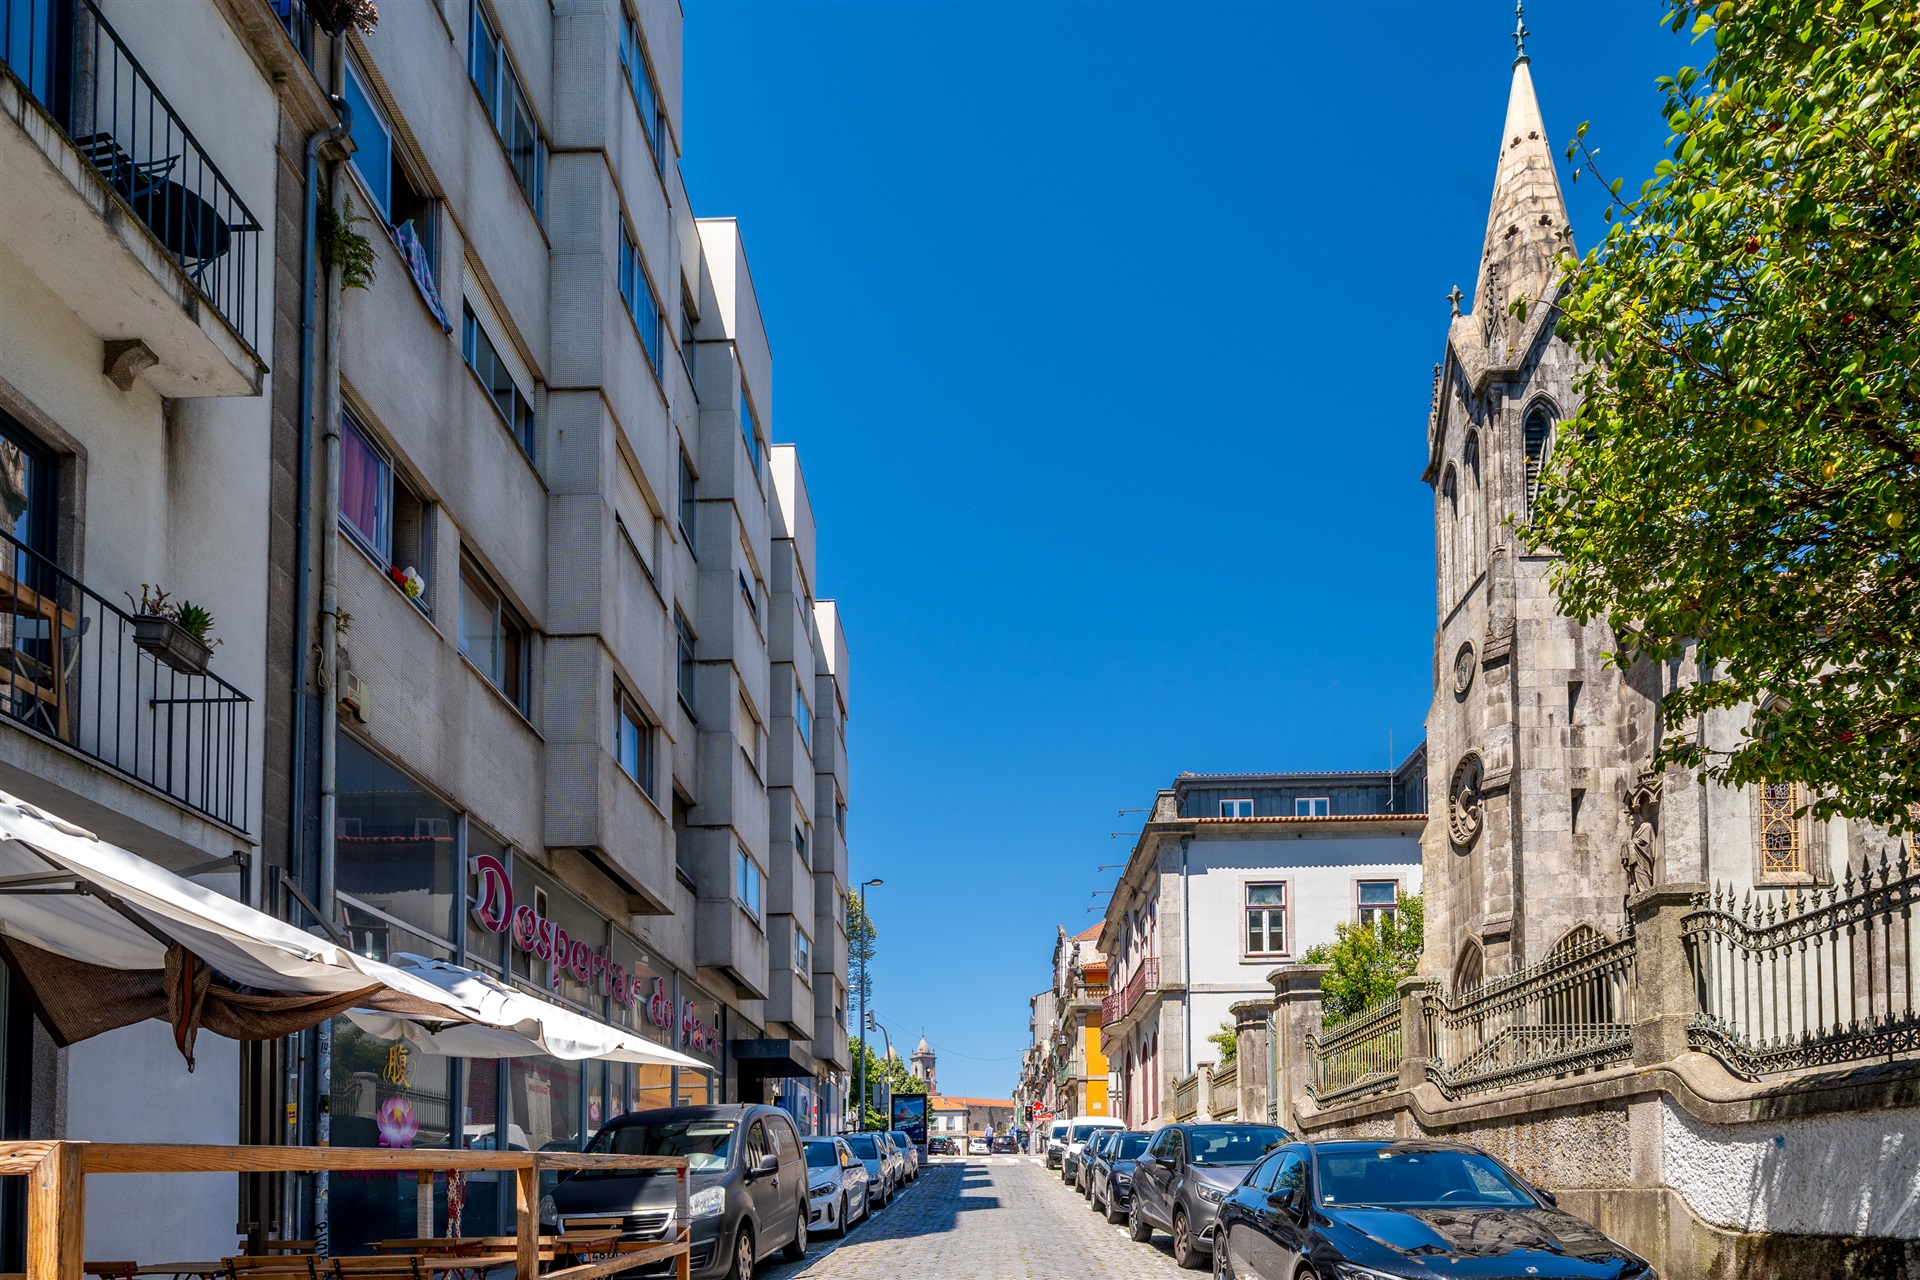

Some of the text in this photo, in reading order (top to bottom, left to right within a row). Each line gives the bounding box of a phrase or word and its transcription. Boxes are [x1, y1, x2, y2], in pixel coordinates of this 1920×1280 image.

[469, 855, 720, 1058] Despertar do Hara
